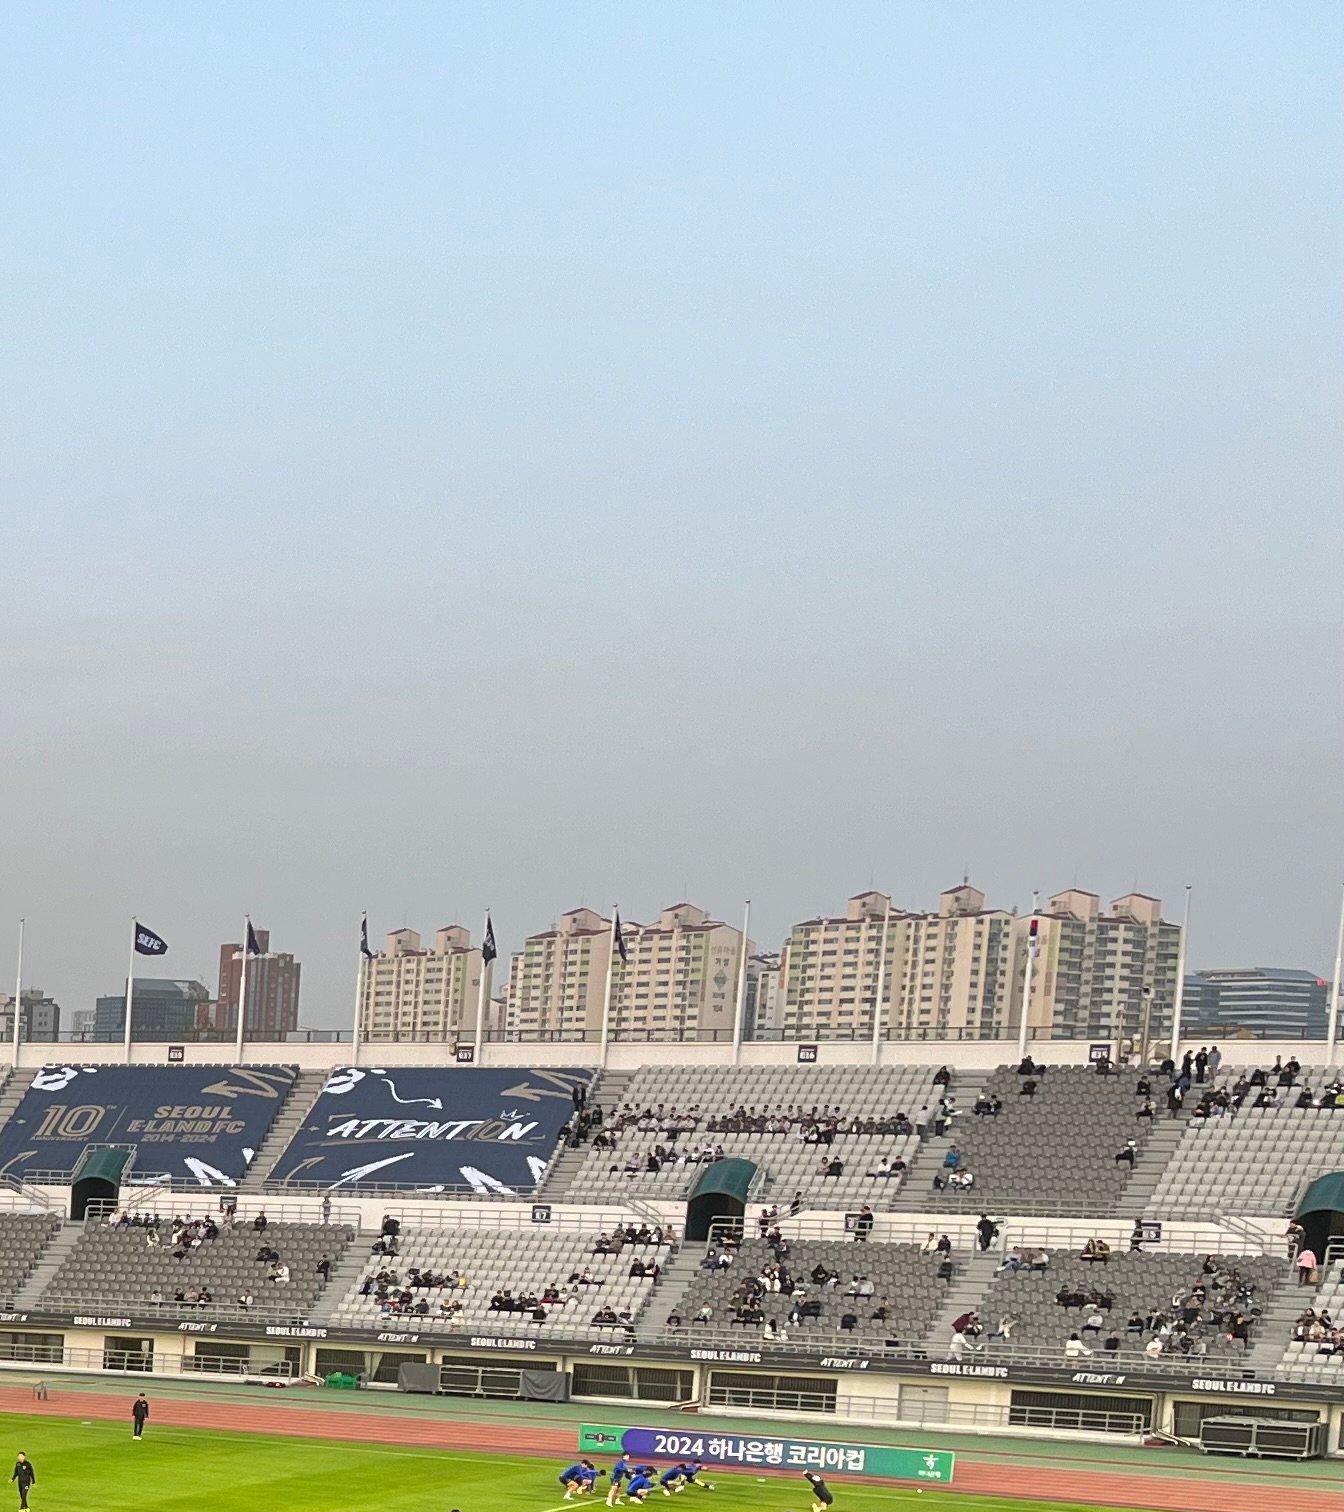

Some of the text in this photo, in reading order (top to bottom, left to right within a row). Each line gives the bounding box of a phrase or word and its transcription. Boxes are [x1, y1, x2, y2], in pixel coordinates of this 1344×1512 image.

[154, 1105, 233, 1119] SEOUL
[211, 1120, 246, 1134] FC
[265, 1326, 290, 1336] SEOUL
[470, 1337, 498, 1348] SEOUL
[690, 1349, 719, 1360] SEOUL
[930, 1363, 962, 1375] SEOUL
[1191, 1378, 1226, 1392] SEOUL
[653, 1434, 865, 1472] 2024 하나은행 코리아컵
